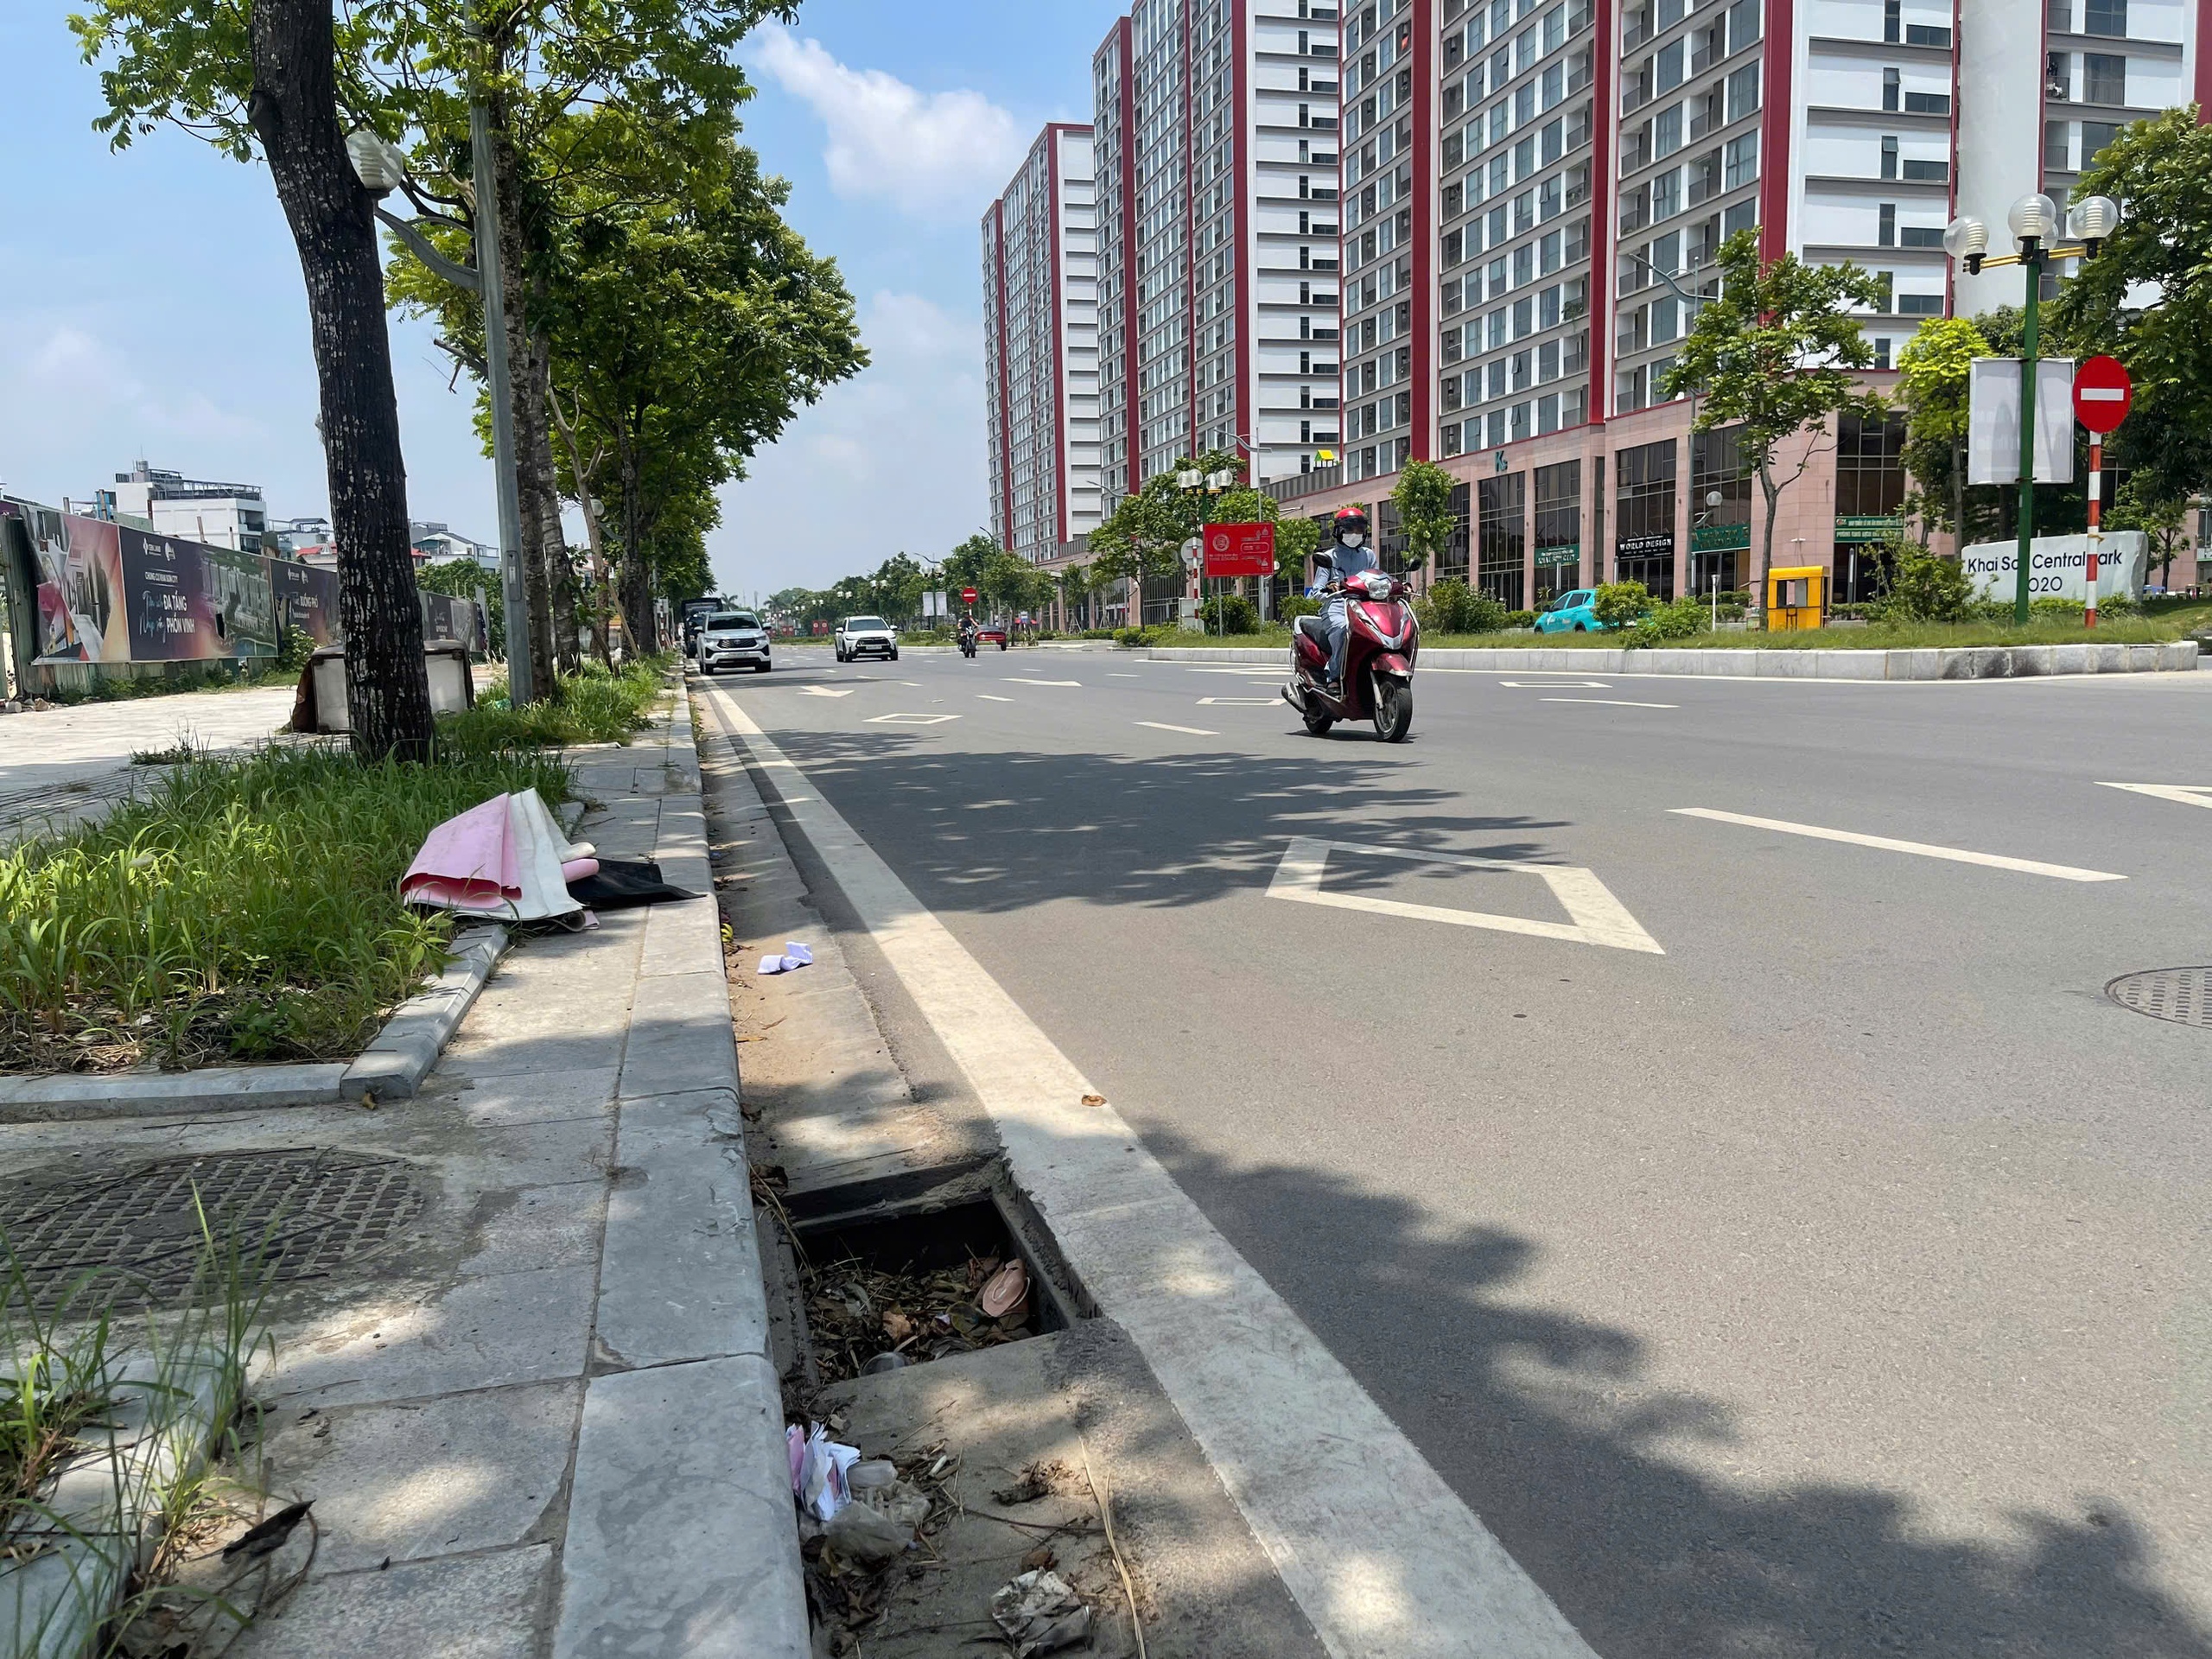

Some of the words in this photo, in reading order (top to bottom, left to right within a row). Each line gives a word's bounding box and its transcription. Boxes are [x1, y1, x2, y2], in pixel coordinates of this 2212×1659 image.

[1619, 541, 1643, 551] WORLD
[1645, 538, 1672, 548] DESIGN
[1967, 556, 1999, 573] Khai
[2032, 550, 2087, 569] Central
[2097, 549, 2123, 567] ark
[2028, 576, 2063, 594] 020
